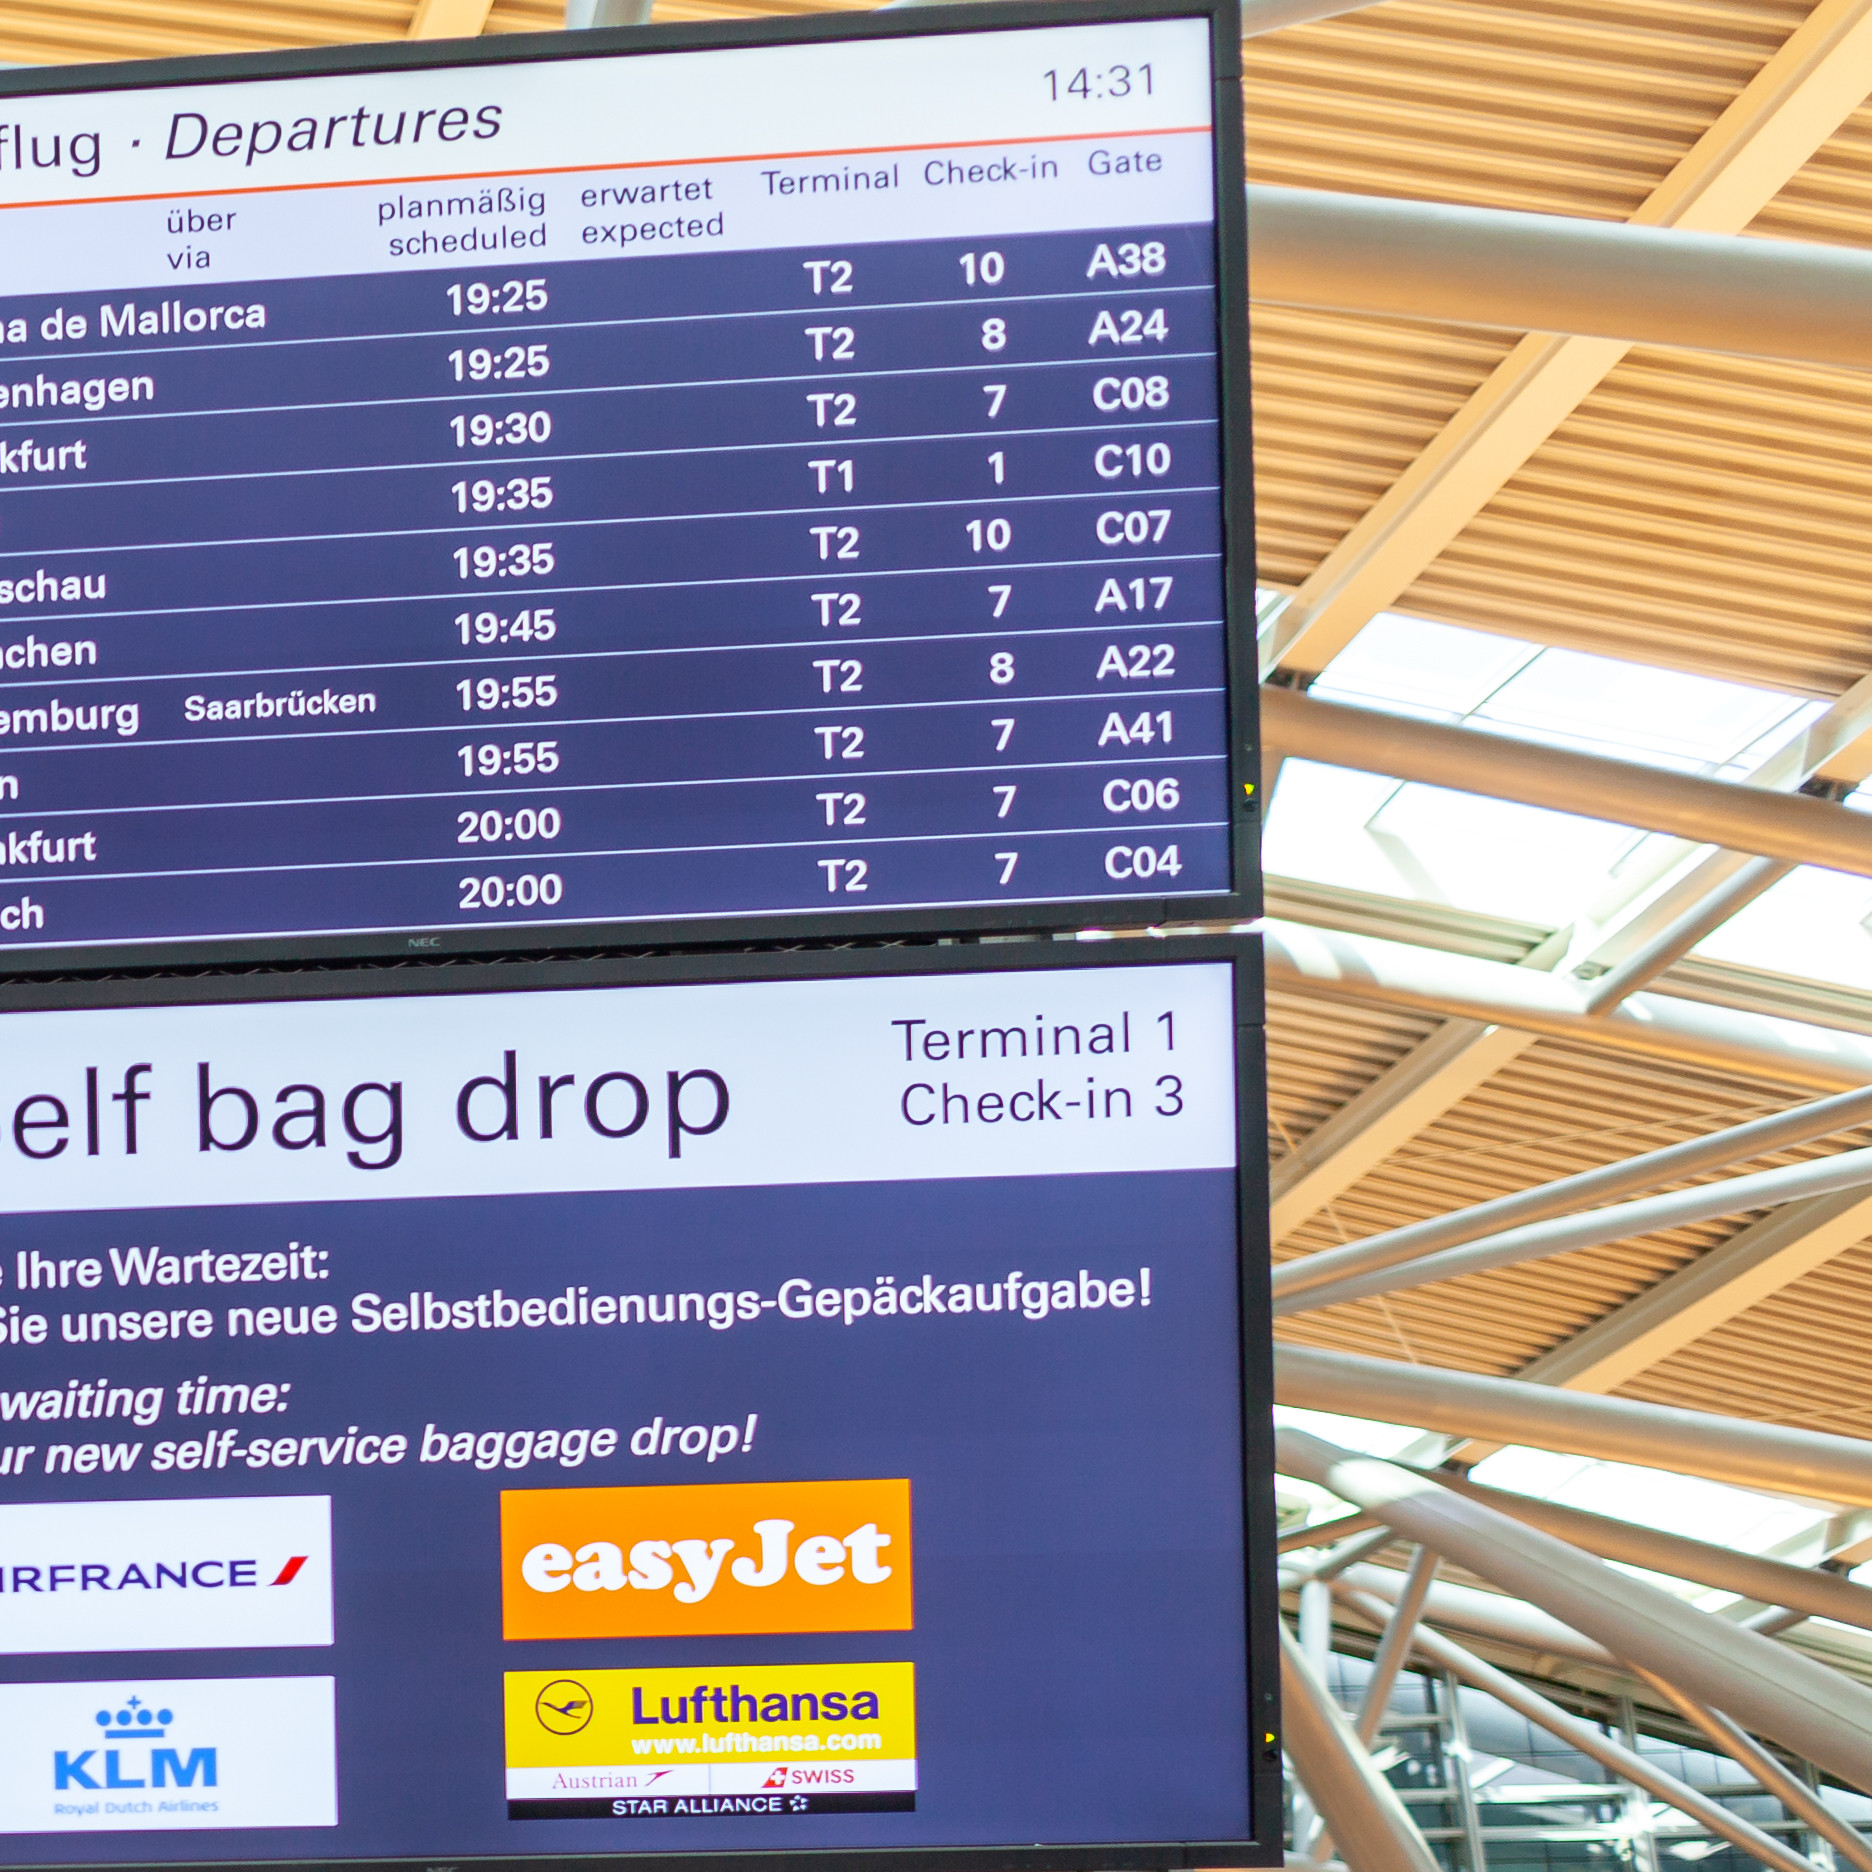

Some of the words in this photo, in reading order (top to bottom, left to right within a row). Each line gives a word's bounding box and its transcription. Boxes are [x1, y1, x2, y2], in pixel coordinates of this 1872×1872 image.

[184, 688, 376, 722] Saarbrücken
[456, 674, 558, 711] 19:55
[812, 659, 863, 693] T2
[989, 652, 1015, 684] 8
[1096, 643, 1175, 679] A22
[892, 1012, 1133, 1062] Terminal
[1157, 1010, 1174, 1051] 1
[196, 1061, 403, 1171] bag
[455, 1049, 730, 1160] drop
[900, 1076, 1132, 1126] Check-in
[1155, 1074, 1183, 1117] 3
[17, 1249, 104, 1291] Ihre
[108, 1242, 330, 1289] Wartezeit:
[61, 1309, 213, 1343] unsere
[228, 1304, 338, 1337] neue
[351, 1267, 1151, 1333] Selbstbedienungs-Gepäckaufgabe!
[0, 1378, 164, 1426] waiting
[176, 1375, 291, 1416] time:
[44, 1442, 143, 1474] new
[150, 1425, 408, 1471] self-service
[419, 1423, 618, 1470] baggage
[630, 1413, 758, 1463] drop!
[520, 1516, 893, 1604] easyJet
[632, 1685, 880, 1726] Lufthansa
[631, 1731, 883, 1755] www.lufthansa.com
[53, 1746, 218, 1791] KLM
[551, 1771, 639, 1790] Austrian
[790, 1768, 856, 1786] SWISS
[54, 1801, 100, 1818] Royal
[105, 1800, 152, 1814] Dutch
[157, 1799, 219, 1813] Airlines
[611, 1798, 672, 1816] STAR
[674, 1796, 783, 1815] ALLIANCE
